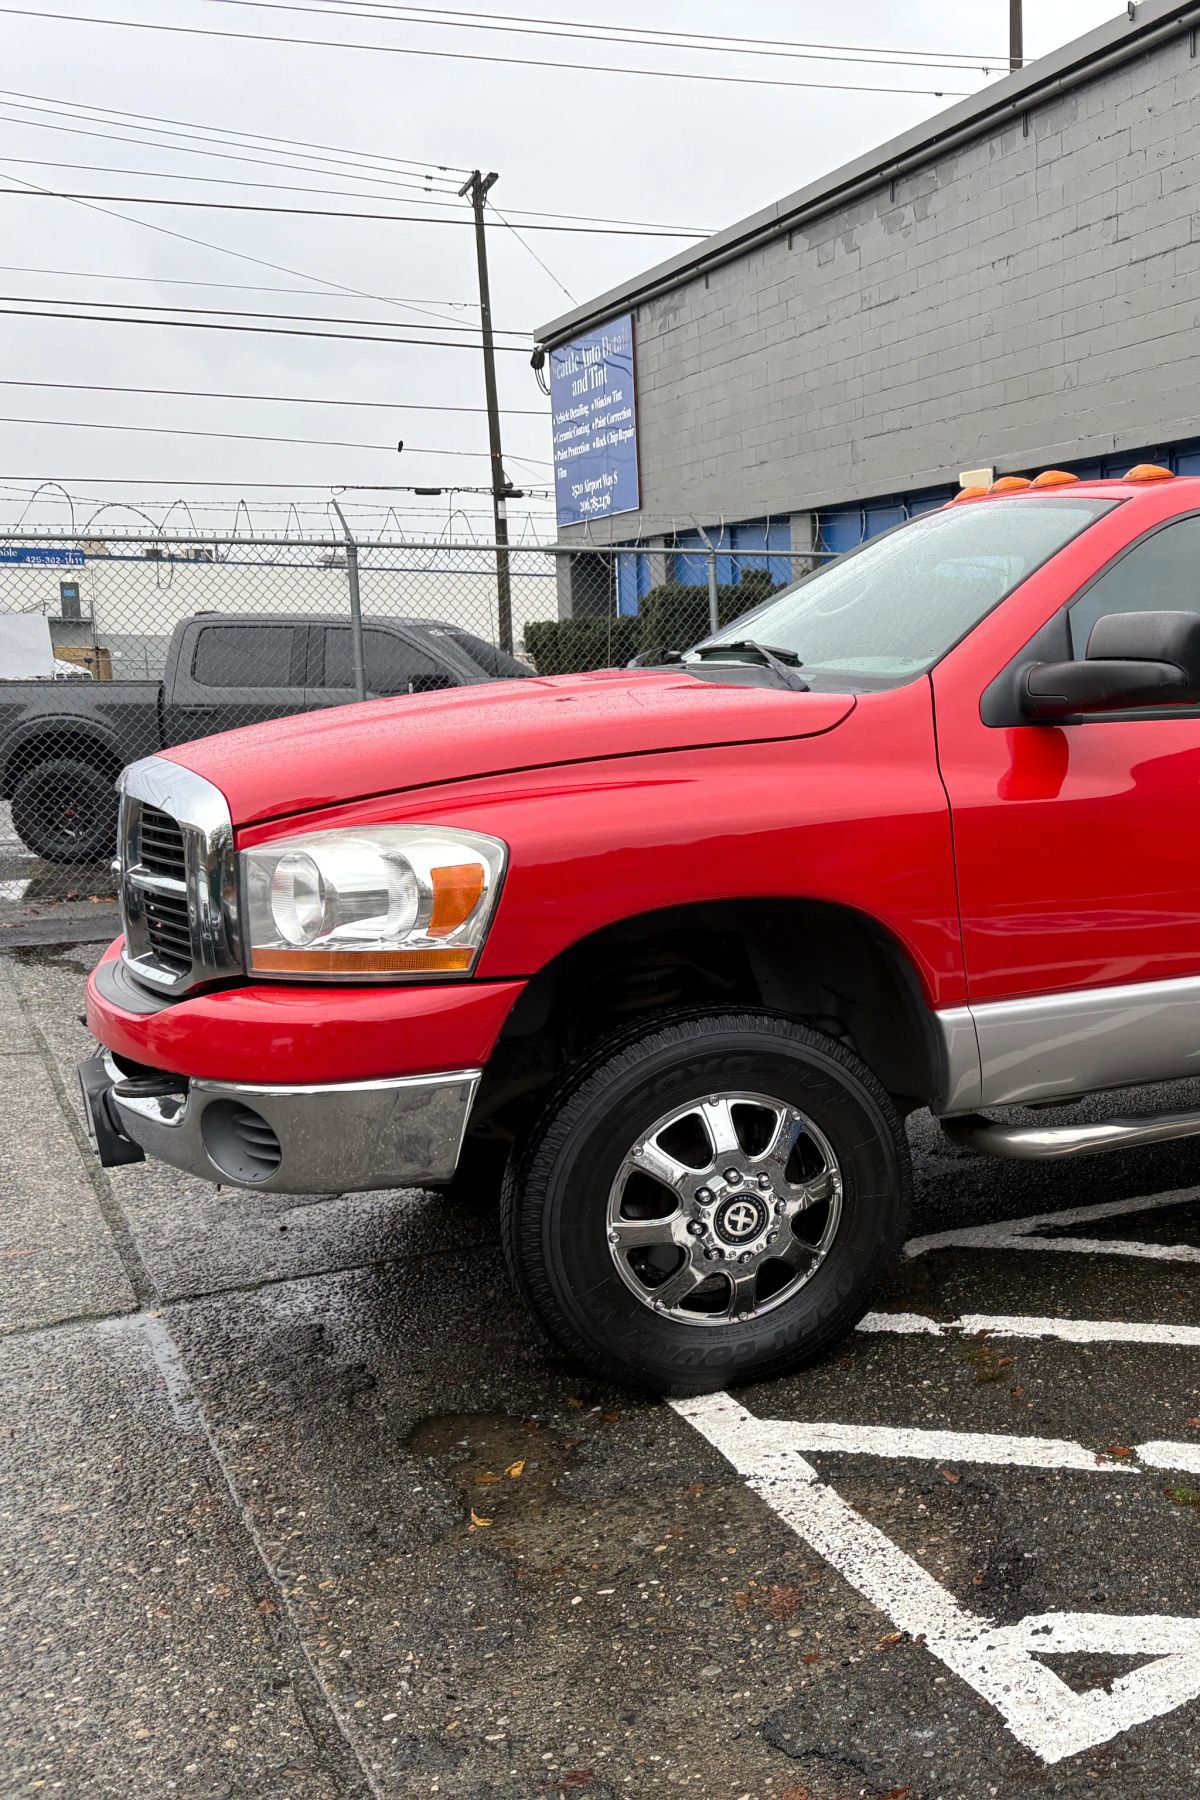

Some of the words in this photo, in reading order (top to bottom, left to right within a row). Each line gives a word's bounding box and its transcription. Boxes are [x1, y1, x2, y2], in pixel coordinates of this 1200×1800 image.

[582, 345, 601, 368] Auto
[572, 369, 588, 396] and
[588, 364, 608, 389] Tint
[607, 407, 632, 425] Correction
[596, 435, 607, 448] Rock
[607, 430, 618, 446] Chip
[619, 425, 635, 443] Repair
[568, 442, 590, 457] Protection
[584, 477, 602, 495] Airport
[613, 470, 618, 485] S
